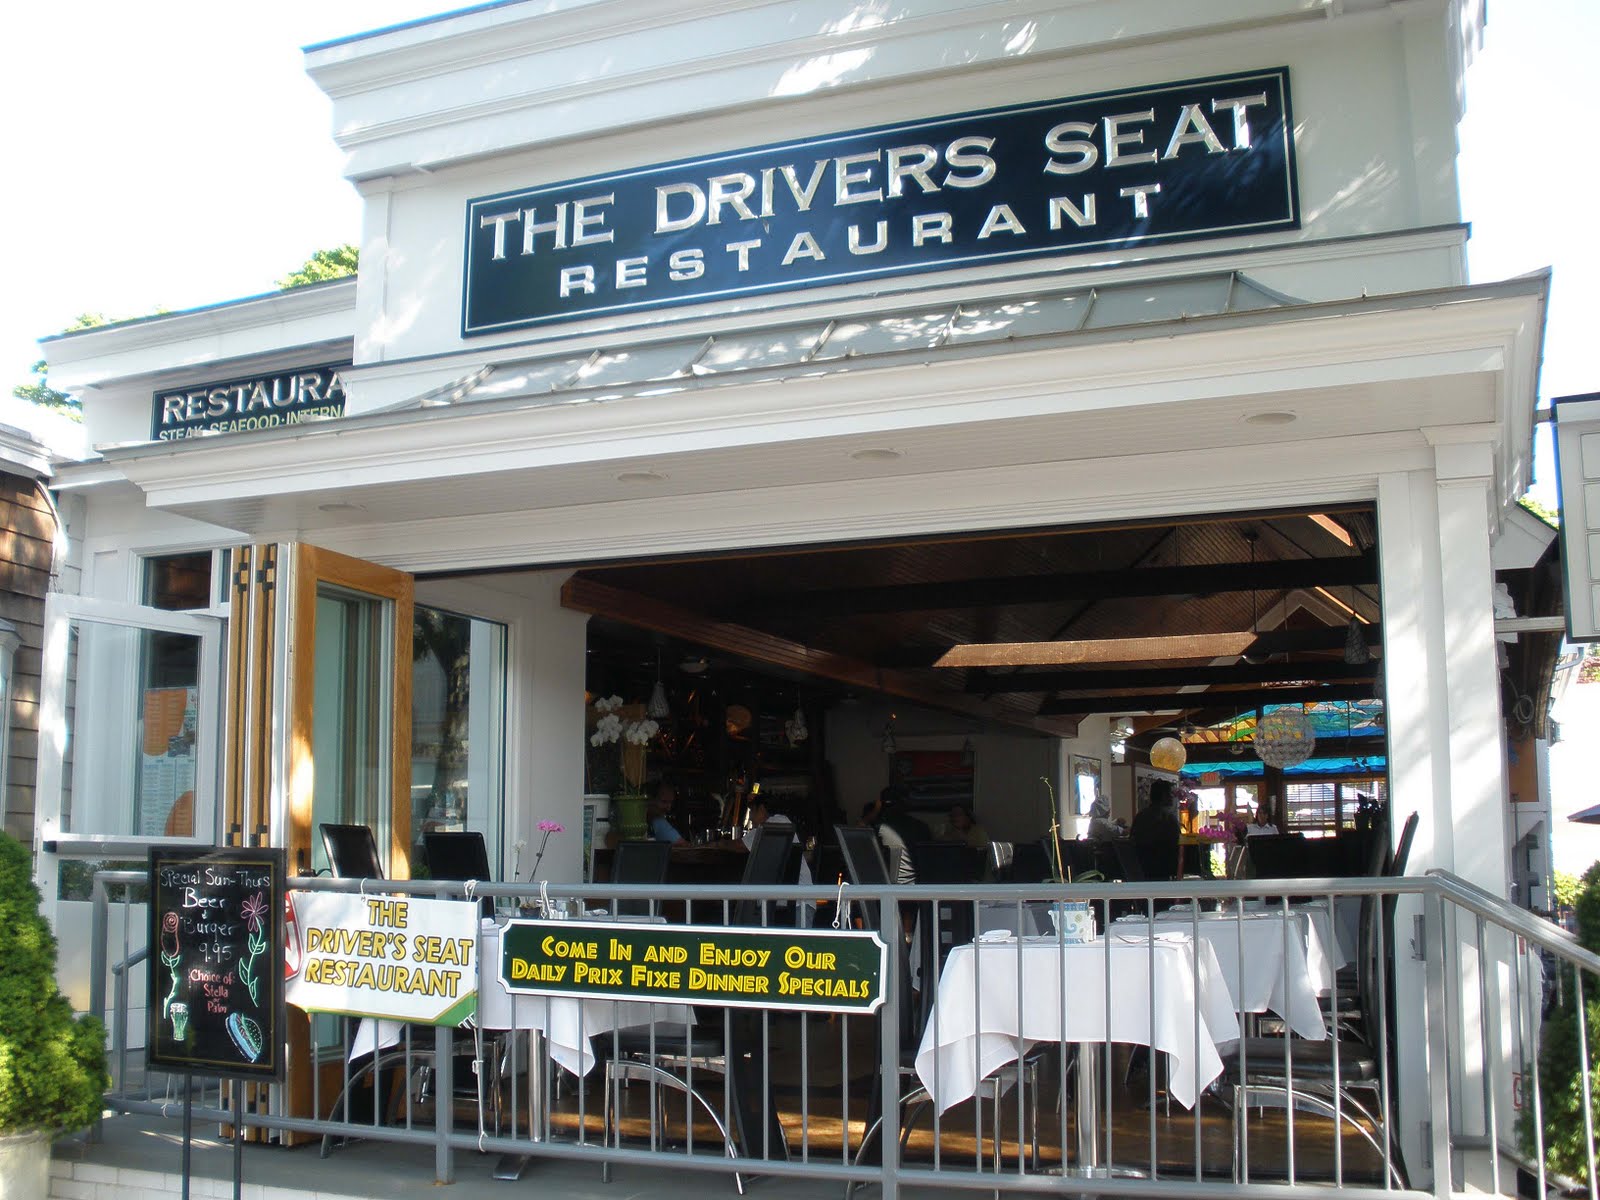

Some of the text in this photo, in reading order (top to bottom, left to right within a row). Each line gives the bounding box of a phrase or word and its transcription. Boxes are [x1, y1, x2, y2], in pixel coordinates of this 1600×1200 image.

[480, 91, 1267, 260] THE DRIVERS SEAT
[559, 182, 1161, 297] RESTAURANT
[179, 886, 226, 909] Beer
[368, 899, 408, 928] THE
[181, 916, 234, 942] Burger
[199, 942, 232, 963] 9.95
[306, 928, 407, 961] DRIVER'S
[413, 934, 474, 966] SEAT
[541, 935, 836, 971] COME IN AND ENJOY OUR
[190, 968, 220, 983] Choice
[305, 958, 461, 997] RESTAURANT
[511, 958, 870, 999] DAILY PRIX FIXE DINNER SPECIALS
[203, 983, 229, 998] Stella
[207, 1000, 227, 1014] Palm
